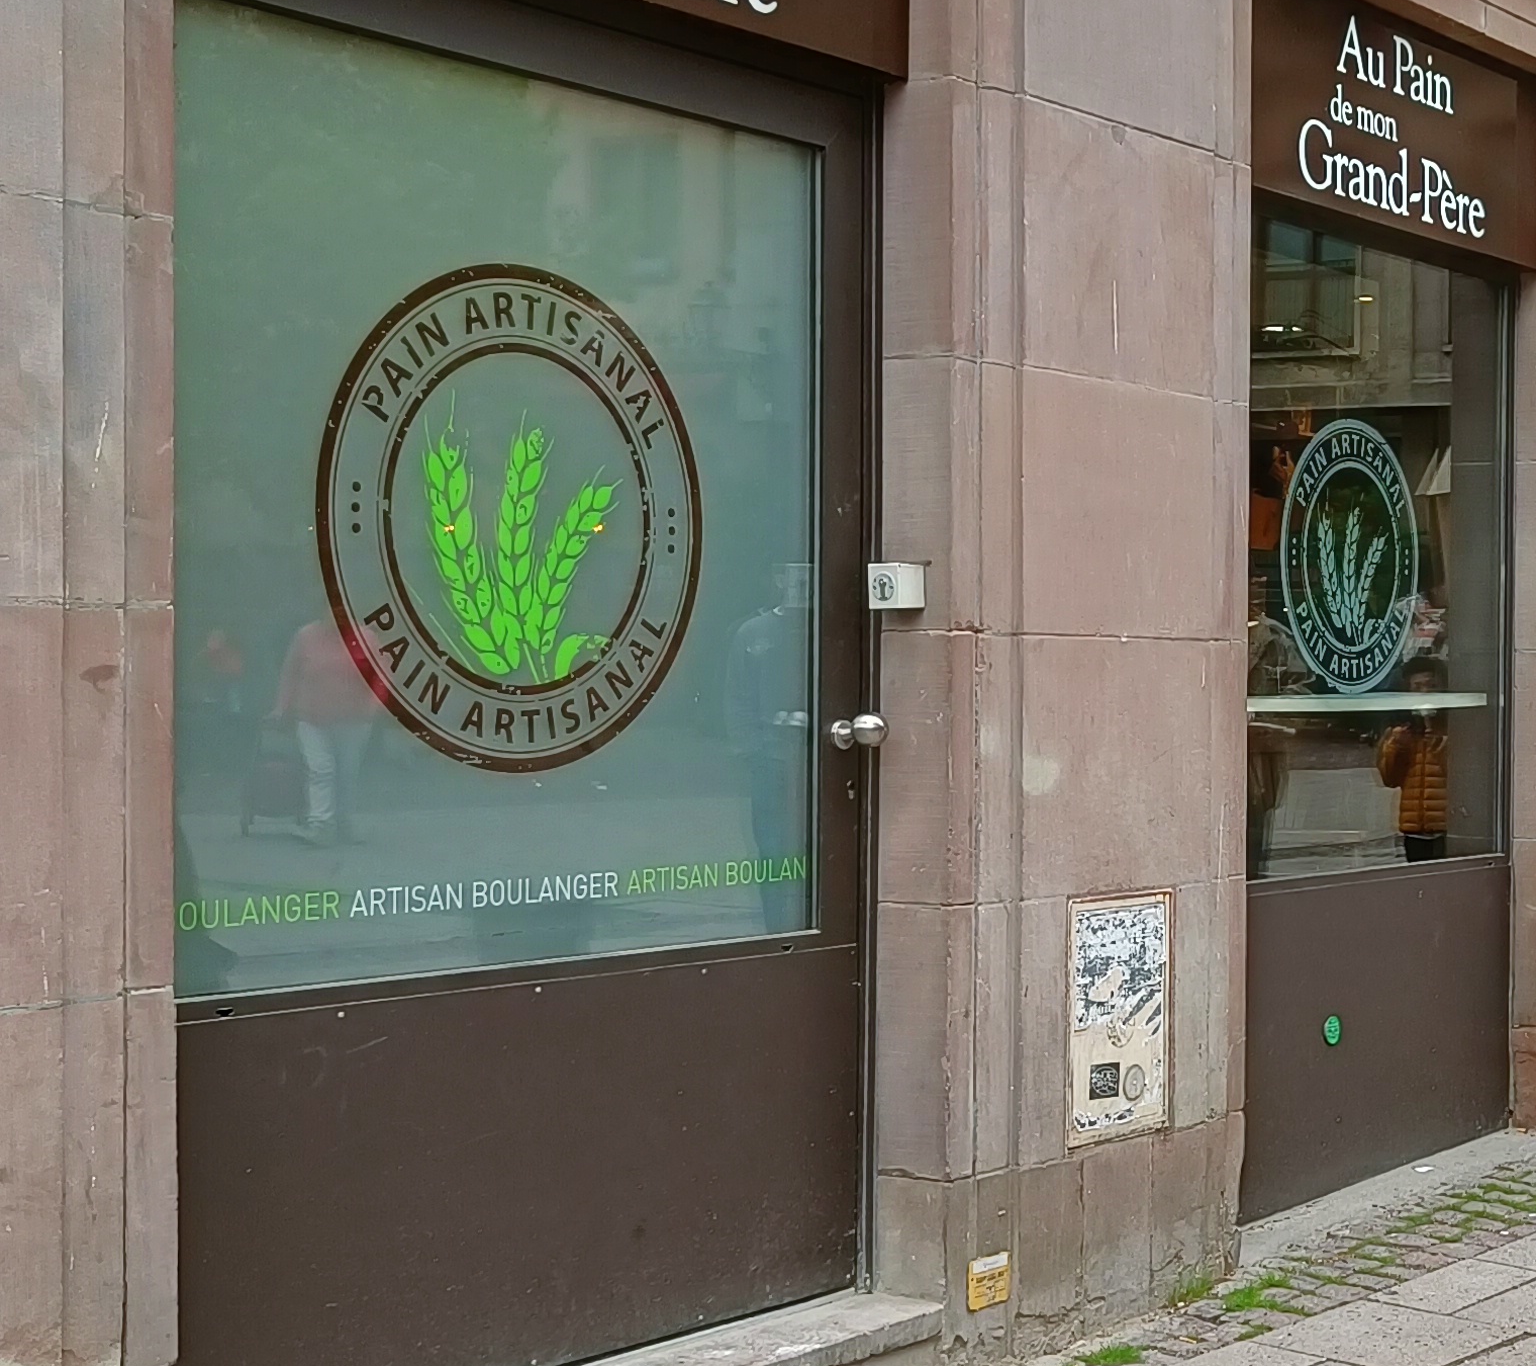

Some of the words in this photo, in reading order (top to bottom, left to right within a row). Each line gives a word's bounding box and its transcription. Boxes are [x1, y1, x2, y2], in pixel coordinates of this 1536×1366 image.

[1336, 15, 1386, 88] Au
[1393, 34, 1453, 114] Pain
[1330, 84, 1353, 126] de
[1356, 105, 1398, 142] mon
[1298, 118, 1485, 238] Grand-Père
[361, 311, 449, 423] PAIN
[463, 291, 670, 451] ARTISANAL
[1296, 449, 1328, 508] PAIN
[1331, 434, 1406, 518] ARTISANAL
[363, 601, 447, 715] PAIN
[459, 616, 669, 744] ARTISANAL
[1296, 601, 1327, 663] PAIN
[1329, 609, 1406, 679] ARTISANAL
[350, 882, 463, 919] ARTISAN
[472, 871, 618, 909] BOULANGER
[626, 862, 718, 896] ARTISAN
[725, 855, 806, 886] BOULAN
